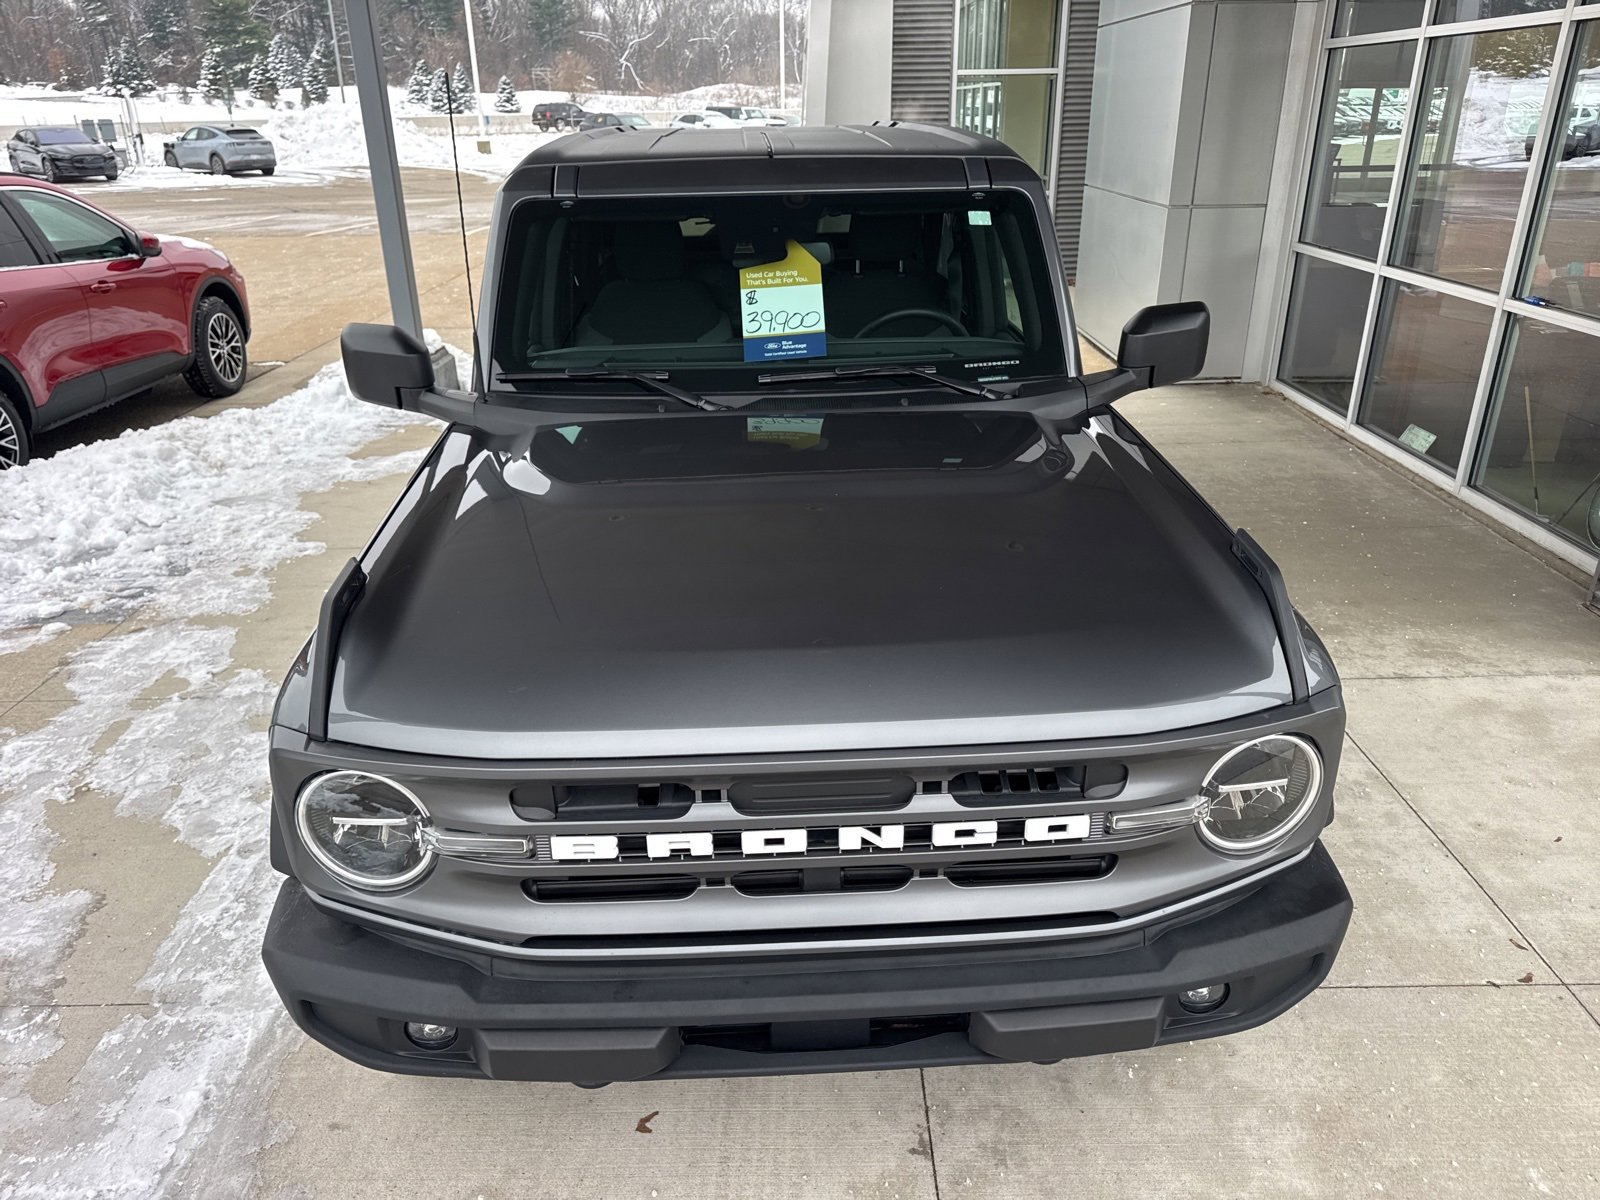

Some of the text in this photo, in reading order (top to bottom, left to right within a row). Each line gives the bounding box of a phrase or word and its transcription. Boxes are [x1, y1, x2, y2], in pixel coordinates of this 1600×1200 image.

[746, 290, 758, 305] $
[964, 360, 1020, 368] BRONCO
[550, 814, 1092, 861] BRONCO
